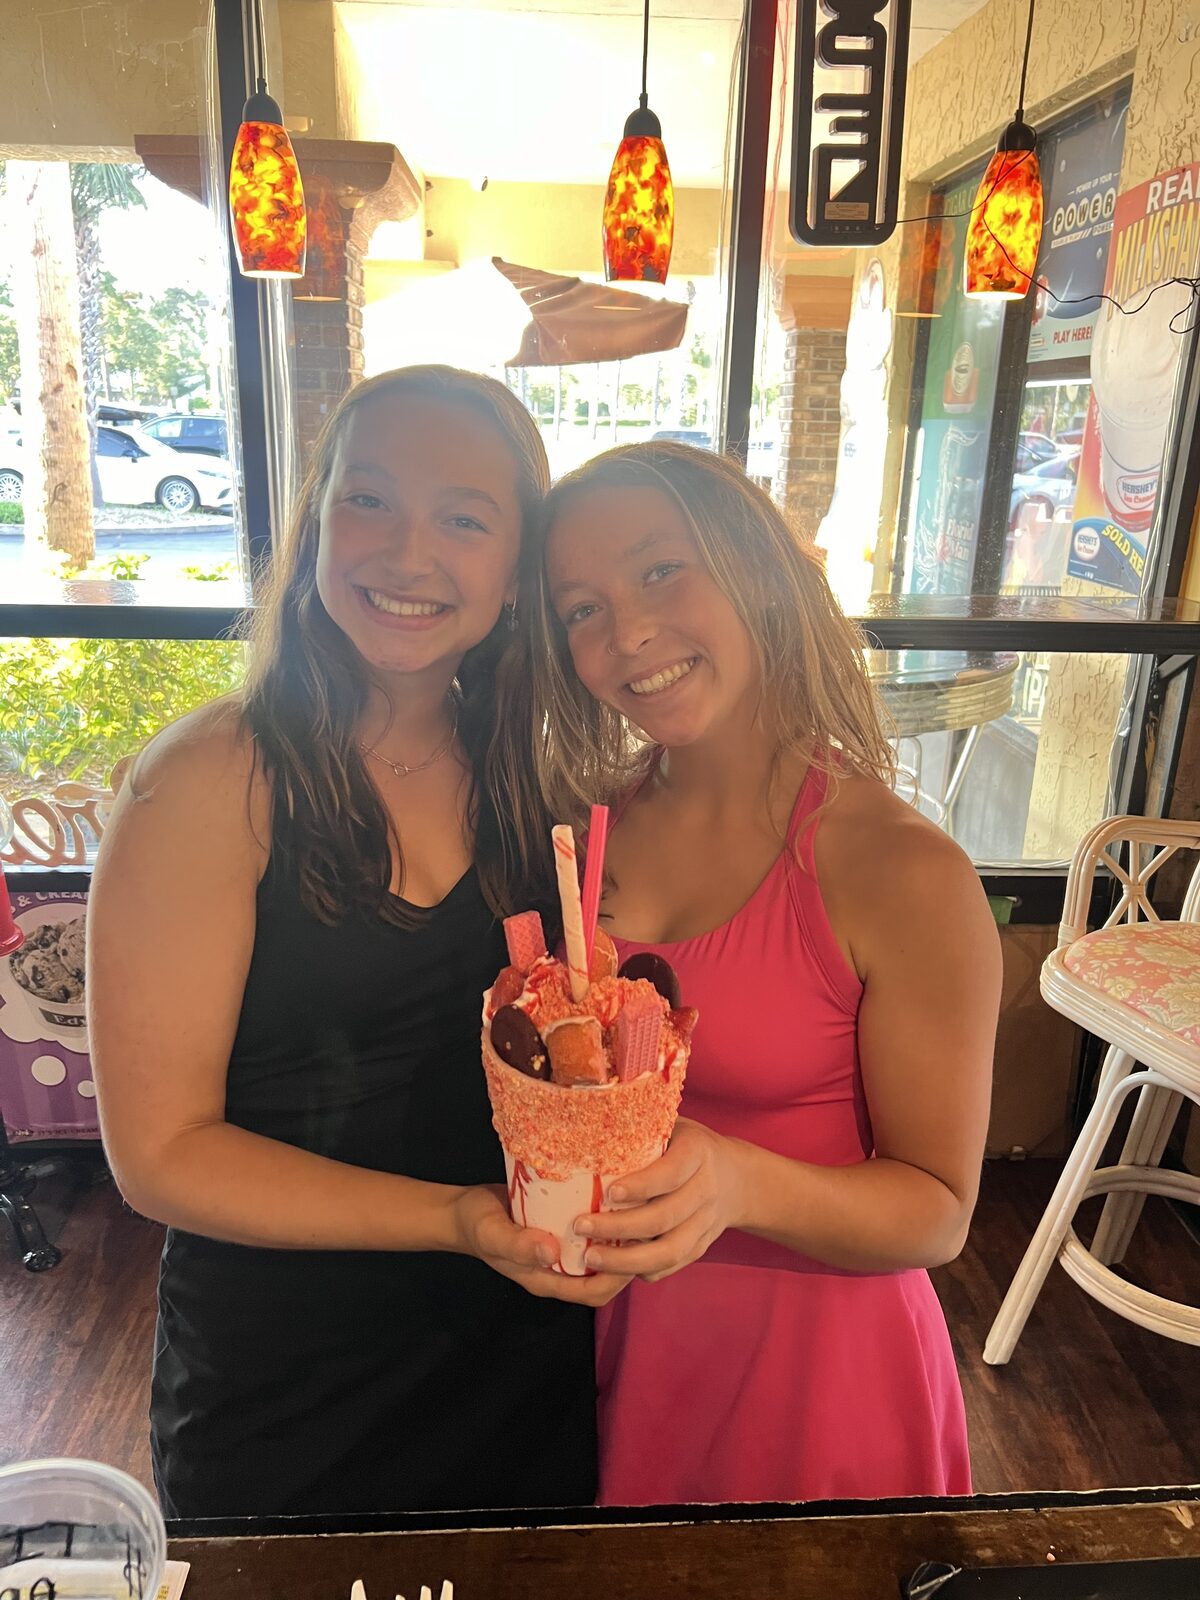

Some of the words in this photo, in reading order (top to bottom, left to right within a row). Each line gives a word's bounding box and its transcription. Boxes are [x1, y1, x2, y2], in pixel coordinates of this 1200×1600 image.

[1053, 187, 1117, 236] POWER
[1146, 167, 1200, 214] REA
[1107, 200, 1200, 322] MILKSHA
[1053, 329, 1071, 345] PLAY
[1071, 325, 1093, 342] HERE!
[1101, 524, 1131, 556] SOLD
[1129, 548, 1145, 579] HE
[17, 895, 33, 908] &
